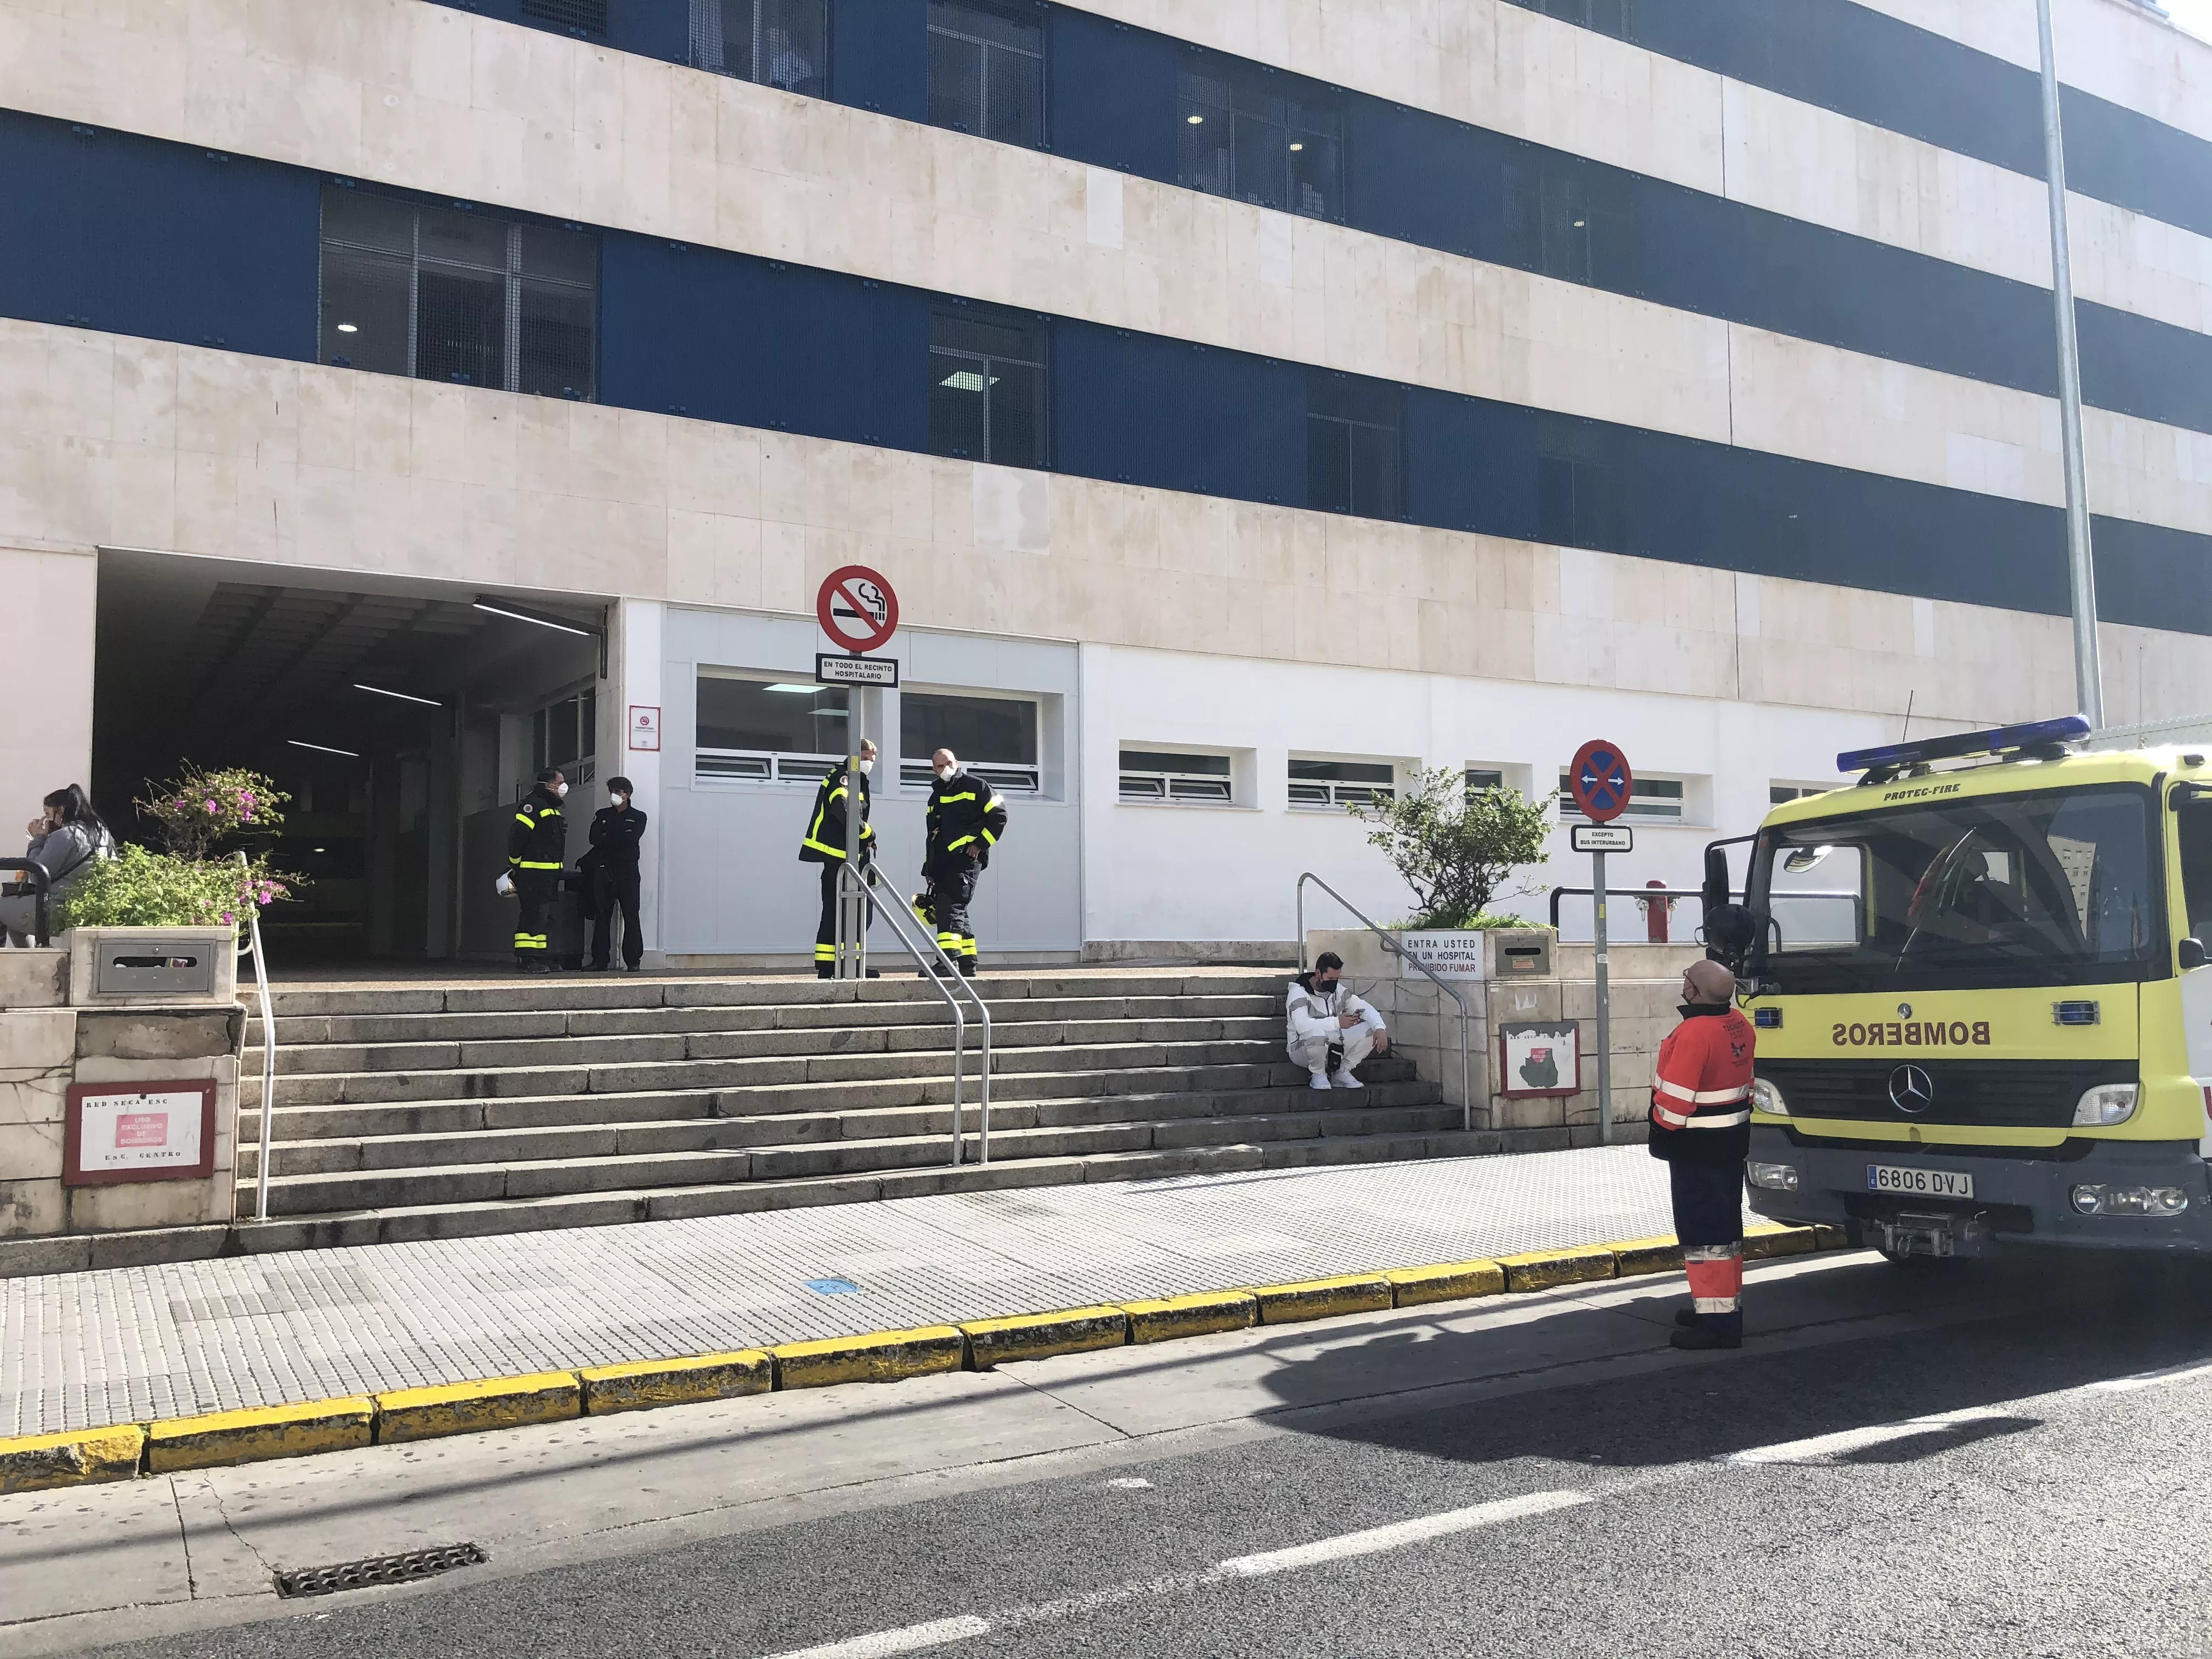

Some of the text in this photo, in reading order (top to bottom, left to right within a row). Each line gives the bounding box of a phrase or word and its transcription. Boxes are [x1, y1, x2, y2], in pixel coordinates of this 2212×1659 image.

[835, 670, 882, 679] HOSPITALARIO
[1883, 783, 1961, 801] PROTEC-FIRE
[1408, 940, 1475, 949] ENTRA USTED
[1408, 951, 1476, 960] N UN HOSPITAL
[1449, 963, 1476, 972] FUMAR
[1878, 1169, 1926, 1190] 6806
[1932, 1173, 1968, 1195] DVJ
